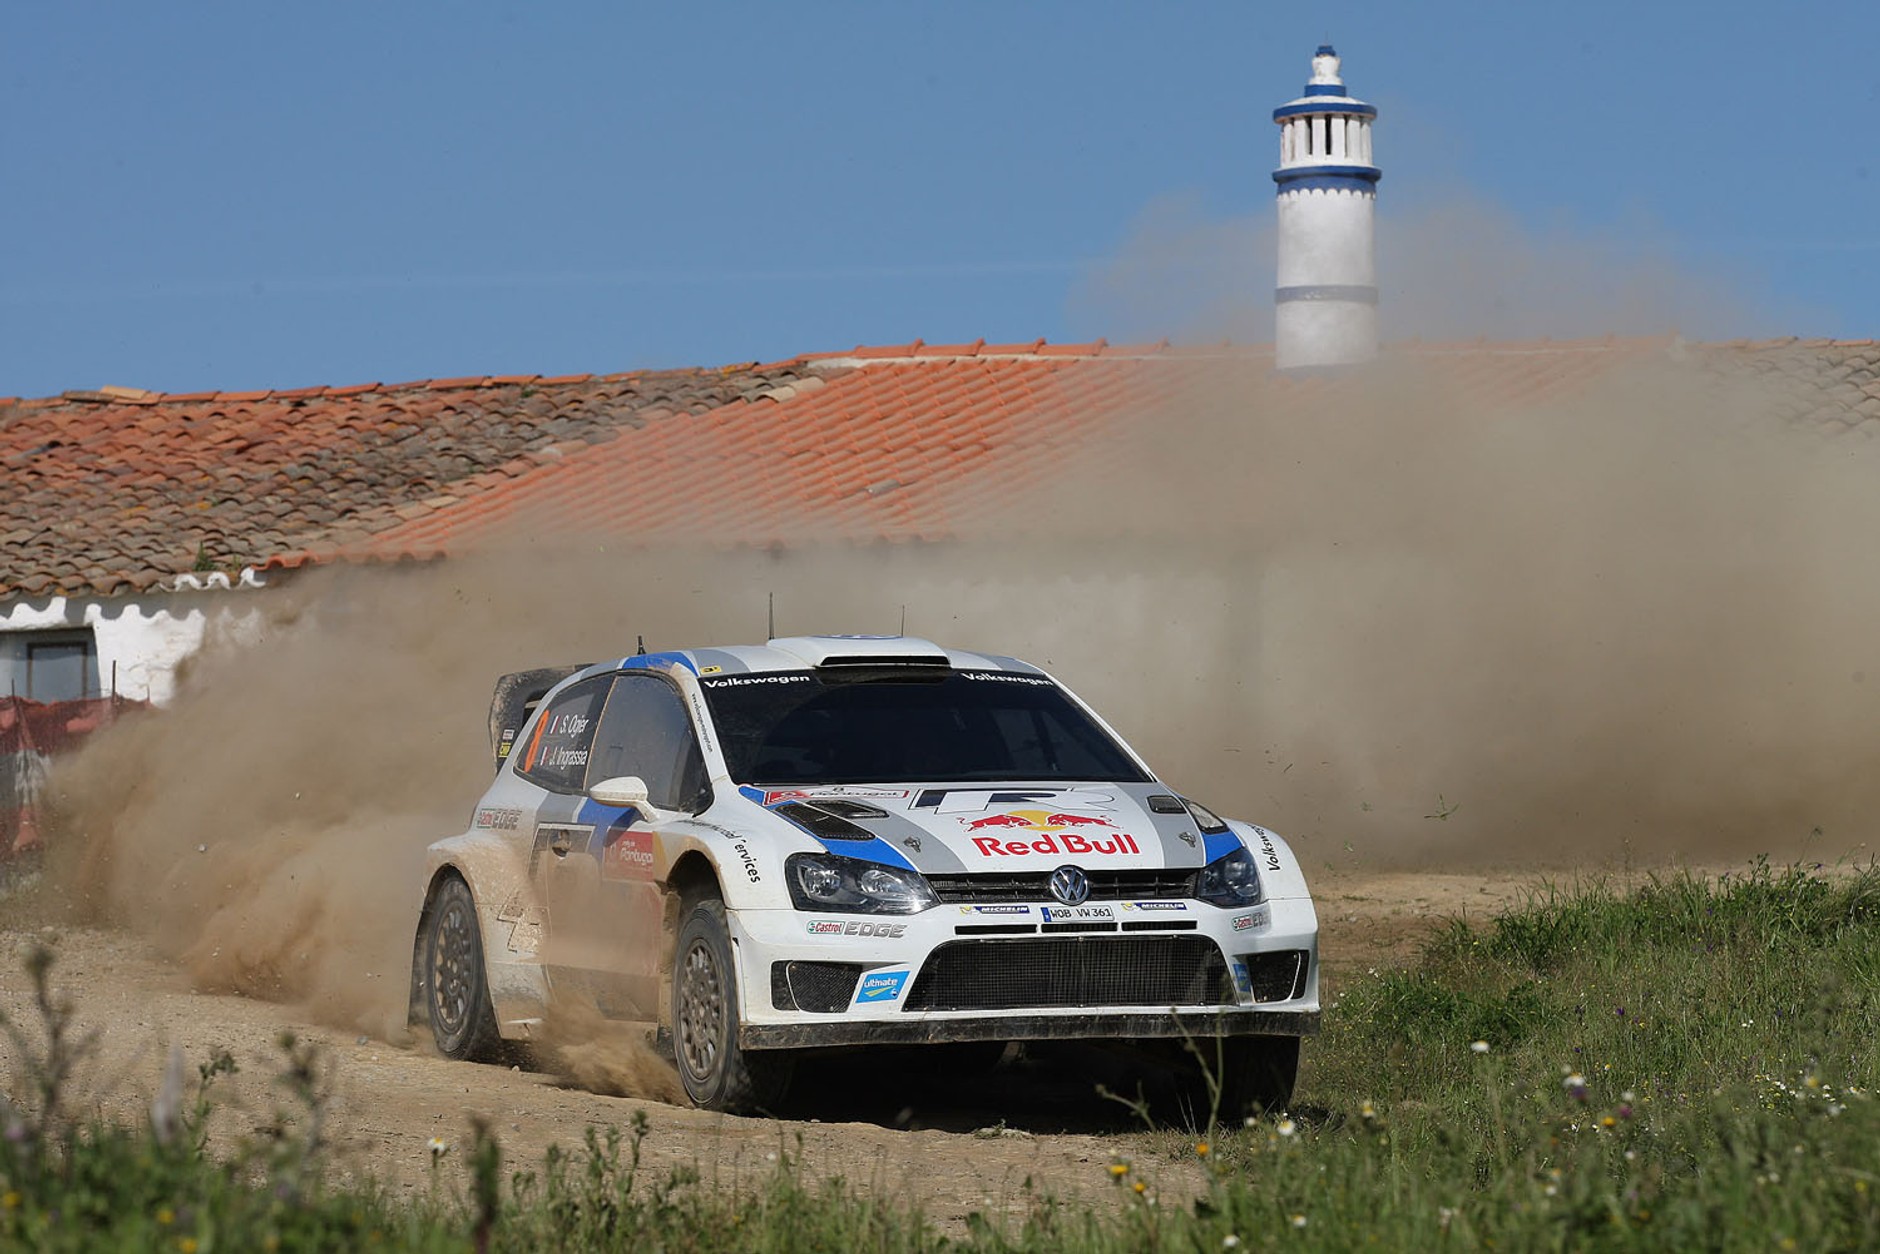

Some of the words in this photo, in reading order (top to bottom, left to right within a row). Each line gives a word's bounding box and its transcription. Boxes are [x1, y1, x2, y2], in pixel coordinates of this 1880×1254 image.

[704, 674, 811, 689] Volkswagen
[960, 672, 1054, 686] Volkswagen
[568, 714, 590, 738] Ogier
[556, 745, 588, 770] Ingrassia
[971, 834, 1060, 857] Red
[1058, 833, 1141, 856] Bull
[1050, 908, 1072, 919] WOB
[1076, 908, 1091, 918] VW
[1092, 908, 1112, 917] 361
[815, 922, 842, 933] Castrol
[844, 921, 907, 938] EDGE
